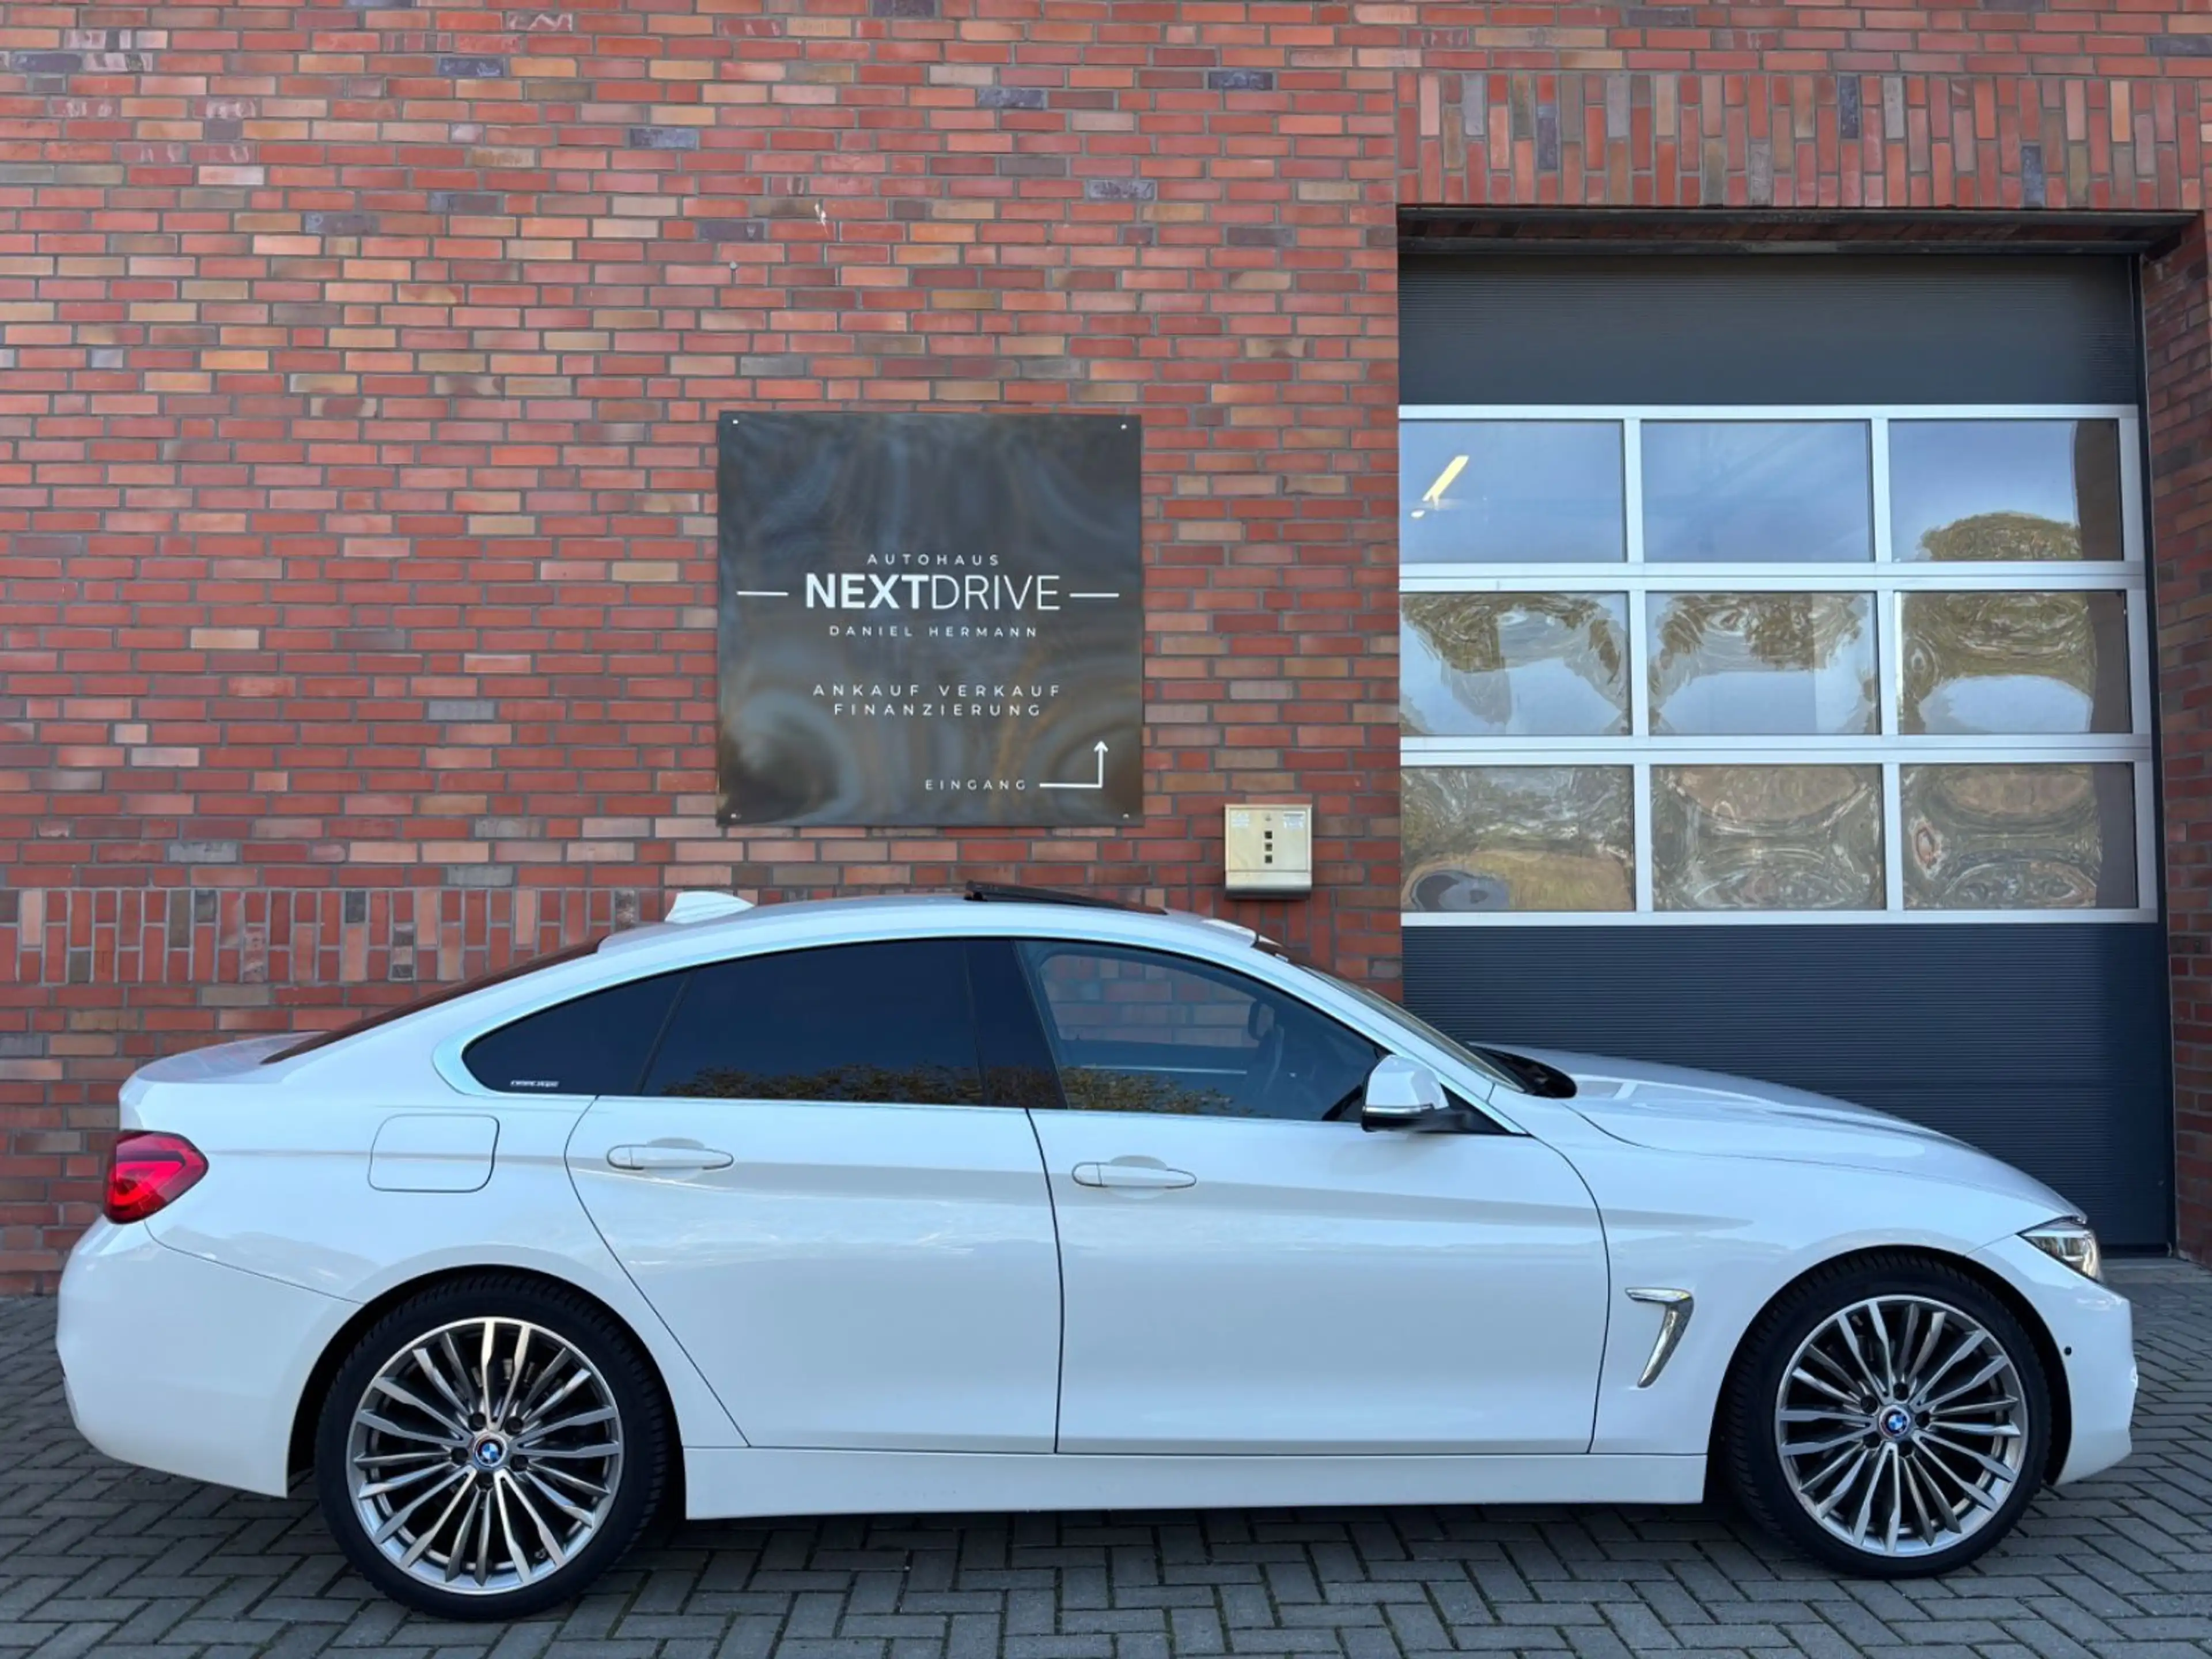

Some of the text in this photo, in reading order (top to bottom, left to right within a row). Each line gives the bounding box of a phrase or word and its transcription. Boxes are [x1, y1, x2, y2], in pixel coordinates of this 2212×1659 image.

[867, 554, 999, 566] AUTOHAUS
[805, 573, 1060, 611] NEXTDRIVE
[830, 626, 1036, 637] DANIEL HERMANN
[813, 684, 1059, 697] ANKAUF VERKAUF
[834, 703, 1039, 716] FINANZIERUNG
[925, 779, 1025, 790] EINGANG
